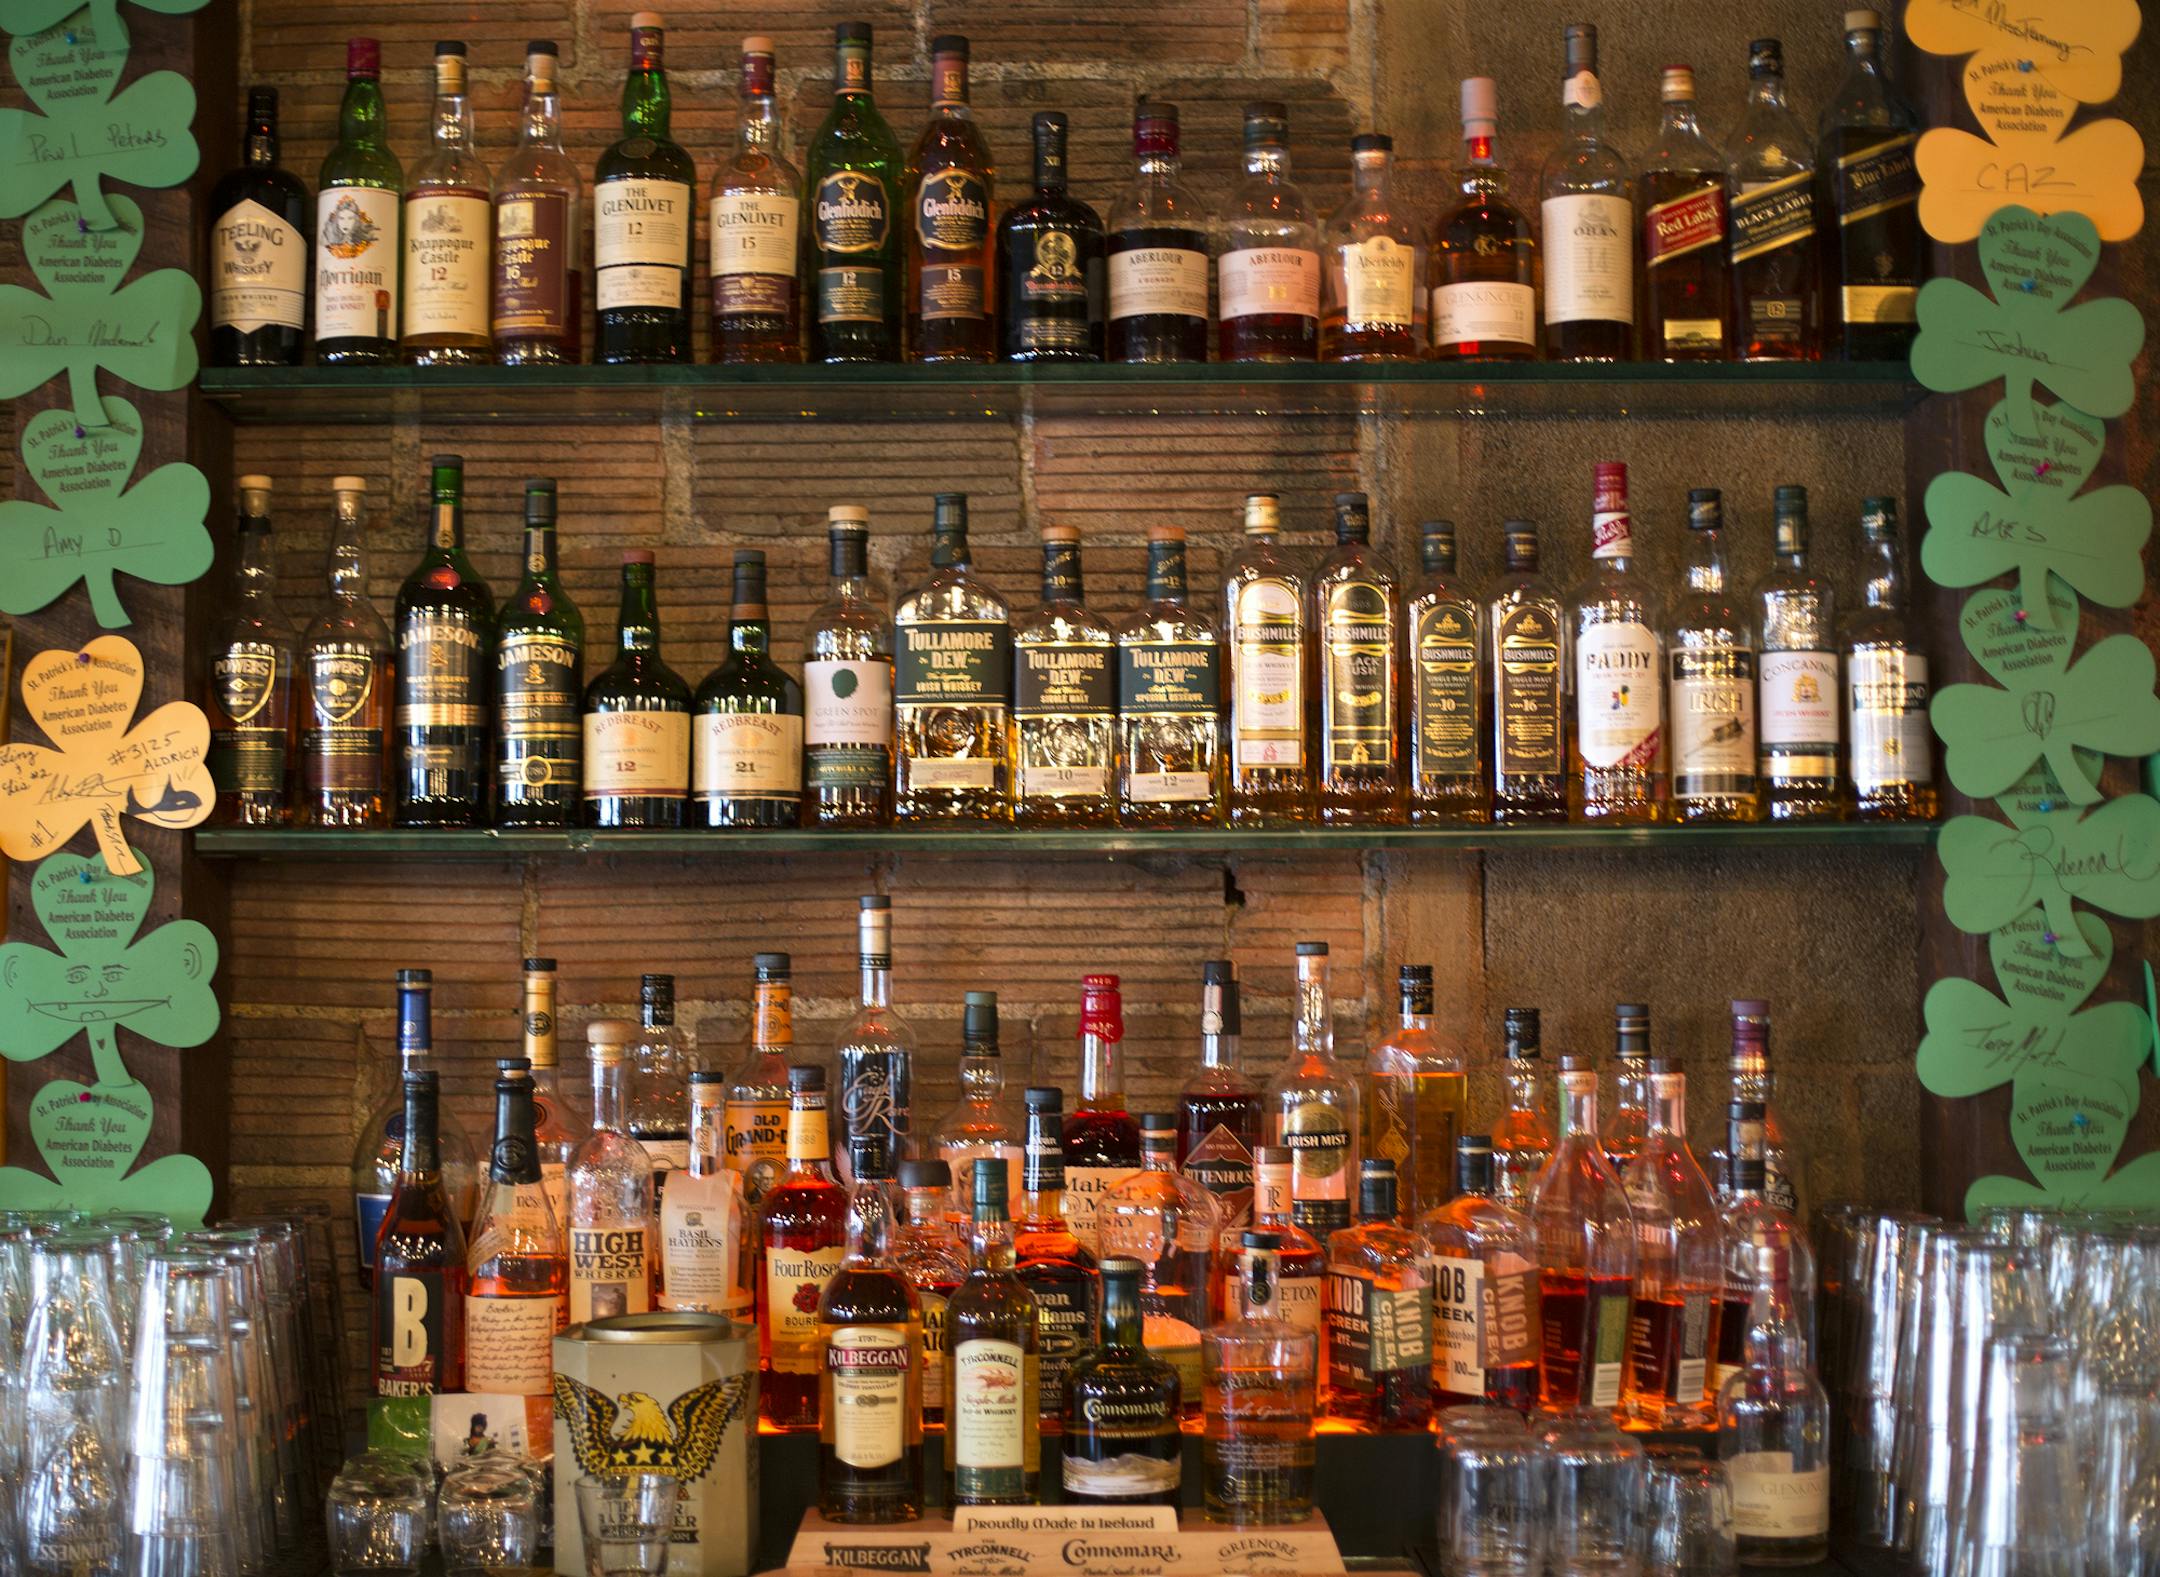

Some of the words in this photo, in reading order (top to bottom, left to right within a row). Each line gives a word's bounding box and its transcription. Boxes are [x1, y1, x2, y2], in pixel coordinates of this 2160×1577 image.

[36, 53, 76, 68] Thank
[79, 50, 106, 68] You
[28, 71, 72, 87] American
[74, 67, 114, 82] Diabetes
[46, 86, 98, 100] Association
[1988, 81, 2027, 99] Thank
[1978, 102, 2023, 117] American
[2024, 104, 2064, 118] Diabetes
[1995, 119, 2048, 134] Association
[624, 187, 649, 198] THE
[602, 198, 675, 217] GLENLIVET
[817, 198, 883, 221] Glenfiddich
[922, 197, 986, 220] Glenfiddich
[1735, 209, 1776, 230] BLACK
[1774, 192, 1814, 217] LABEL
[626, 221, 644, 236] 12
[716, 212, 786, 229] GLENLIVET
[1655, 216, 1685, 238] Red
[1685, 204, 1720, 226] Label
[219, 223, 284, 247] TEELING
[1573, 227, 1618, 238] OBAN
[48, 236, 89, 250] Thank
[91, 235, 118, 253] You
[740, 236, 757, 250] 15
[37, 255, 81, 269] American
[83, 254, 123, 269] Diabetes
[419, 251, 461, 265] Castle
[1128, 253, 1185, 267] ABERLOUR
[1249, 253, 1304, 267] ABERLOUR
[53, 272, 105, 285] Association
[430, 266, 449, 281] 12
[841, 271, 858, 285] 12
[946, 268, 962, 282] 15
[48, 443, 89, 460] Thank
[91, 440, 119, 459] You
[40, 465, 86, 481] American
[86, 459, 127, 474] Diabetes
[58, 478, 111, 494] Association
[399, 624, 482, 651] JAMESON
[903, 628, 995, 651] TULLAMORE
[1236, 626, 1301, 642] BUSHMILLS
[1328, 626, 1392, 642] BUSHMILLS
[1421, 648, 1473, 662] BUSHMILLS
[1503, 648, 1555, 662] BUSHMILLS
[1981, 641, 2026, 660] American
[2026, 634, 2067, 651] Diabetes
[497, 644, 577, 671] JAMESON
[1025, 649, 1106, 671] TULLAMORE
[1129, 648, 1210, 669] TULLAMORE
[1586, 651, 1651, 670] PADDY
[2001, 653, 2054, 673] Association
[92, 659, 138, 679] Association
[215, 659, 270, 677] POWERS
[314, 660, 365, 677] POWERS
[48, 686, 89, 703] Thank
[92, 681, 119, 700] You
[943, 681, 983, 693] WHISKEY
[1440, 698, 1456, 712] 10
[1522, 698, 1538, 712] 16
[1689, 690, 1744, 712] IRISH
[41, 706, 85, 723] American
[87, 702, 128, 717] Diabetes
[60, 720, 114, 737] Association
[594, 713, 665, 736] REDBREAST
[711, 714, 785, 737] REDBREAST
[143, 746, 200, 772] ALDRICH
[615, 760, 637, 773] 12
[735, 761, 757, 773] 21
[1162, 774, 1179, 787] 12
[56, 888, 98, 905] Thank
[101, 889, 127, 907] You
[48, 910, 93, 924] American
[94, 909, 136, 923] Diabetes
[64, 927, 118, 940] Association
[2001, 959, 2045, 982] American
[2045, 968, 2087, 992] Diabetes
[2013, 979, 2066, 1002] Association
[54, 1115, 96, 1132] Thank
[99, 1116, 127, 1137] You
[752, 1115, 781, 1127] OLD
[2036, 1120, 2076, 1138] Thank
[45, 1139, 90, 1153] American
[91, 1139, 133, 1153] Diabetes
[1287, 1134, 1319, 1148] IRISH
[1320, 1133, 1347, 1146] MIST
[2027, 1143, 2072, 1157] American
[2072, 1142, 2113, 1156] Diabetes
[61, 1154, 115, 1169] Association
[2043, 1159, 2098, 1173] Association
[1183, 1167, 1254, 1186] RITTENHOUS
[574, 1231, 644, 1254] HIGH
[668, 1237, 723, 1248] HAYDEN'S
[679, 1229, 710, 1239] BASIL
[574, 1253, 644, 1269] WEST
[774, 1258, 805, 1277] Four
[574, 1269, 644, 1280] WHISKEY
[393, 1276, 429, 1367] B
[1432, 1305, 1476, 1324] REEK
[1496, 1275, 1528, 1351] KNOB
[1329, 1314, 1370, 1334] CREEK
[1394, 1289, 1425, 1358] KNOB
[1482, 1287, 1501, 1363] CREEK
[1380, 1299, 1398, 1370] CREEK
[828, 1348, 908, 1367] KILBEGGAN
[960, 1352, 1019, 1369] TYRCONNELL
[378, 1378, 434, 1398] BAKER'S
[967, 1516, 1030, 1534] Proudly
[1032, 1515, 1077, 1530] Made
[1081, 1516, 1095, 1529] in
[1099, 1516, 1156, 1530] Ireland
[946, 1544, 1033, 1562] TYRCONNELL
[1061, 1538, 1182, 1567] Connemara
[1218, 1538, 1300, 1558] GREENORE
[831, 1549, 922, 1567] KILBEGGAN
